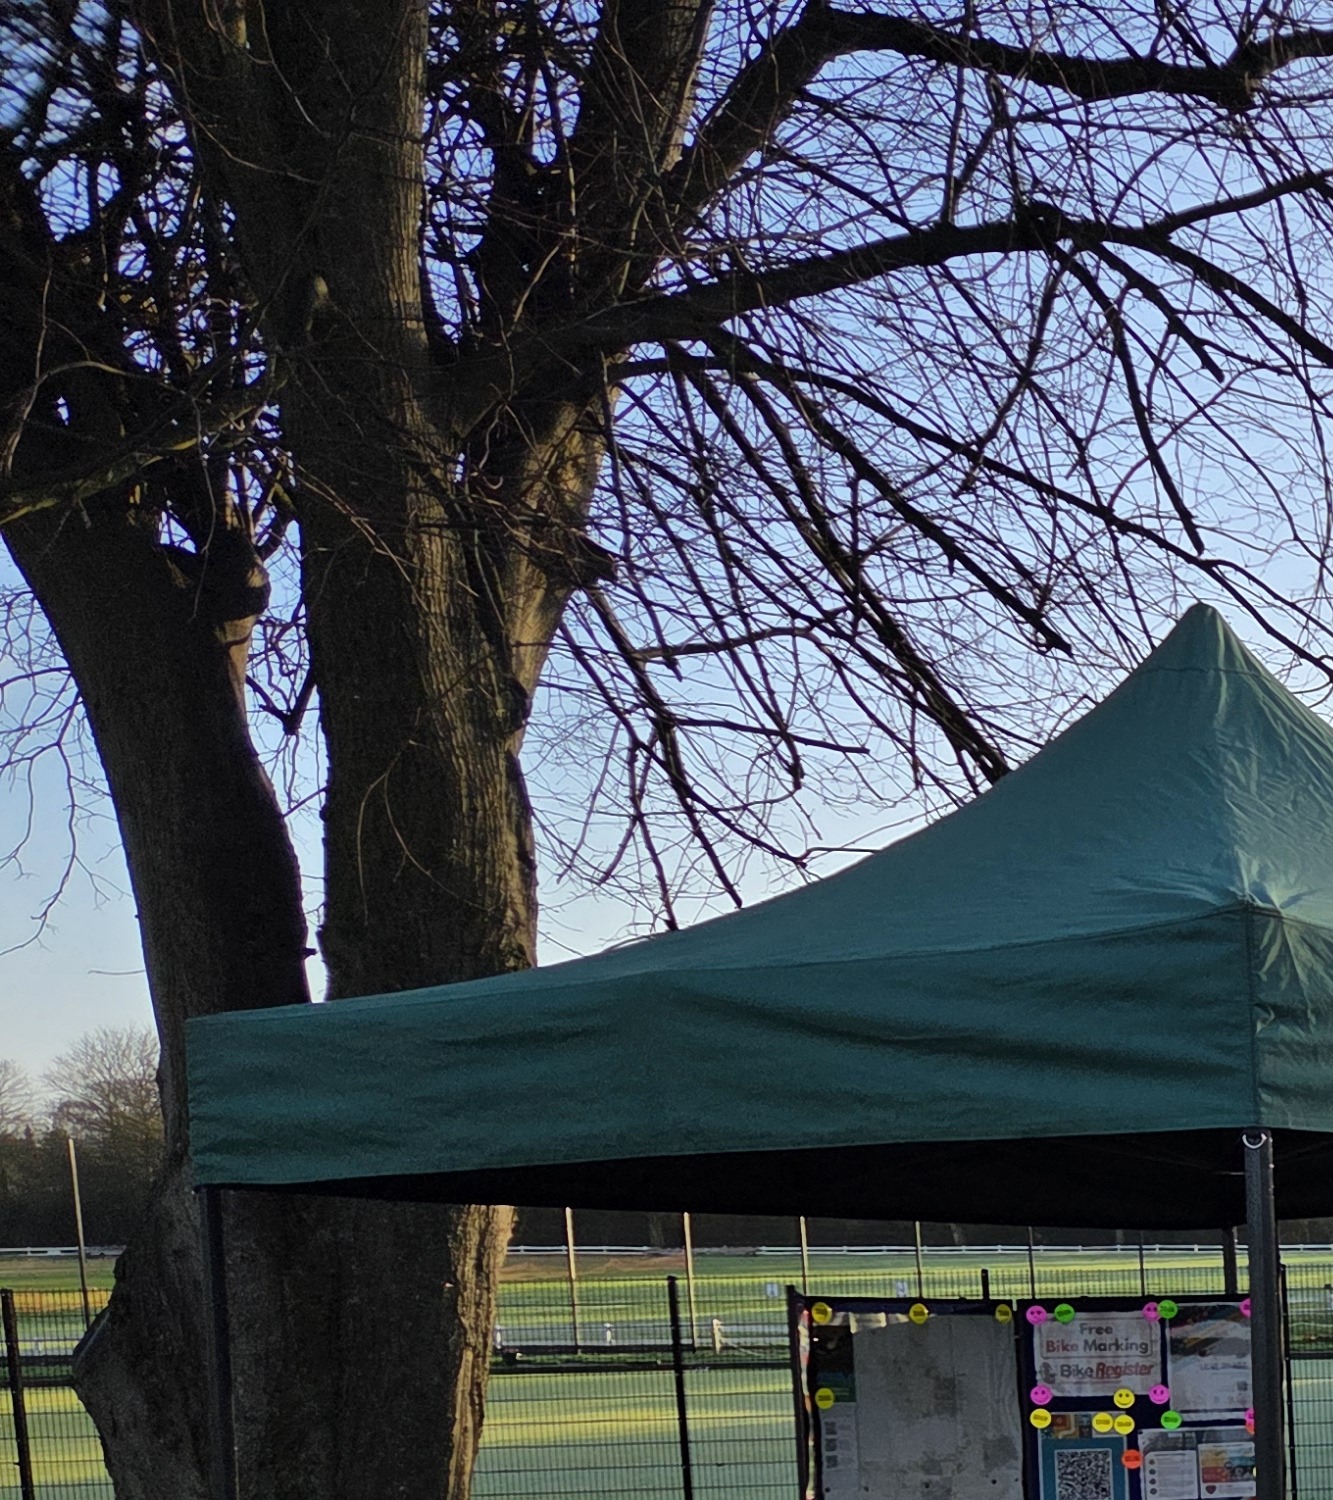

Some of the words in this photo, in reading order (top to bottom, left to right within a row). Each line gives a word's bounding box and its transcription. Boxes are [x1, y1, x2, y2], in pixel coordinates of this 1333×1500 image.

[1080, 1323, 1113, 1335] Free
[1045, 1340, 1079, 1353] Bike
[1083, 1338, 1149, 1354] Marking
